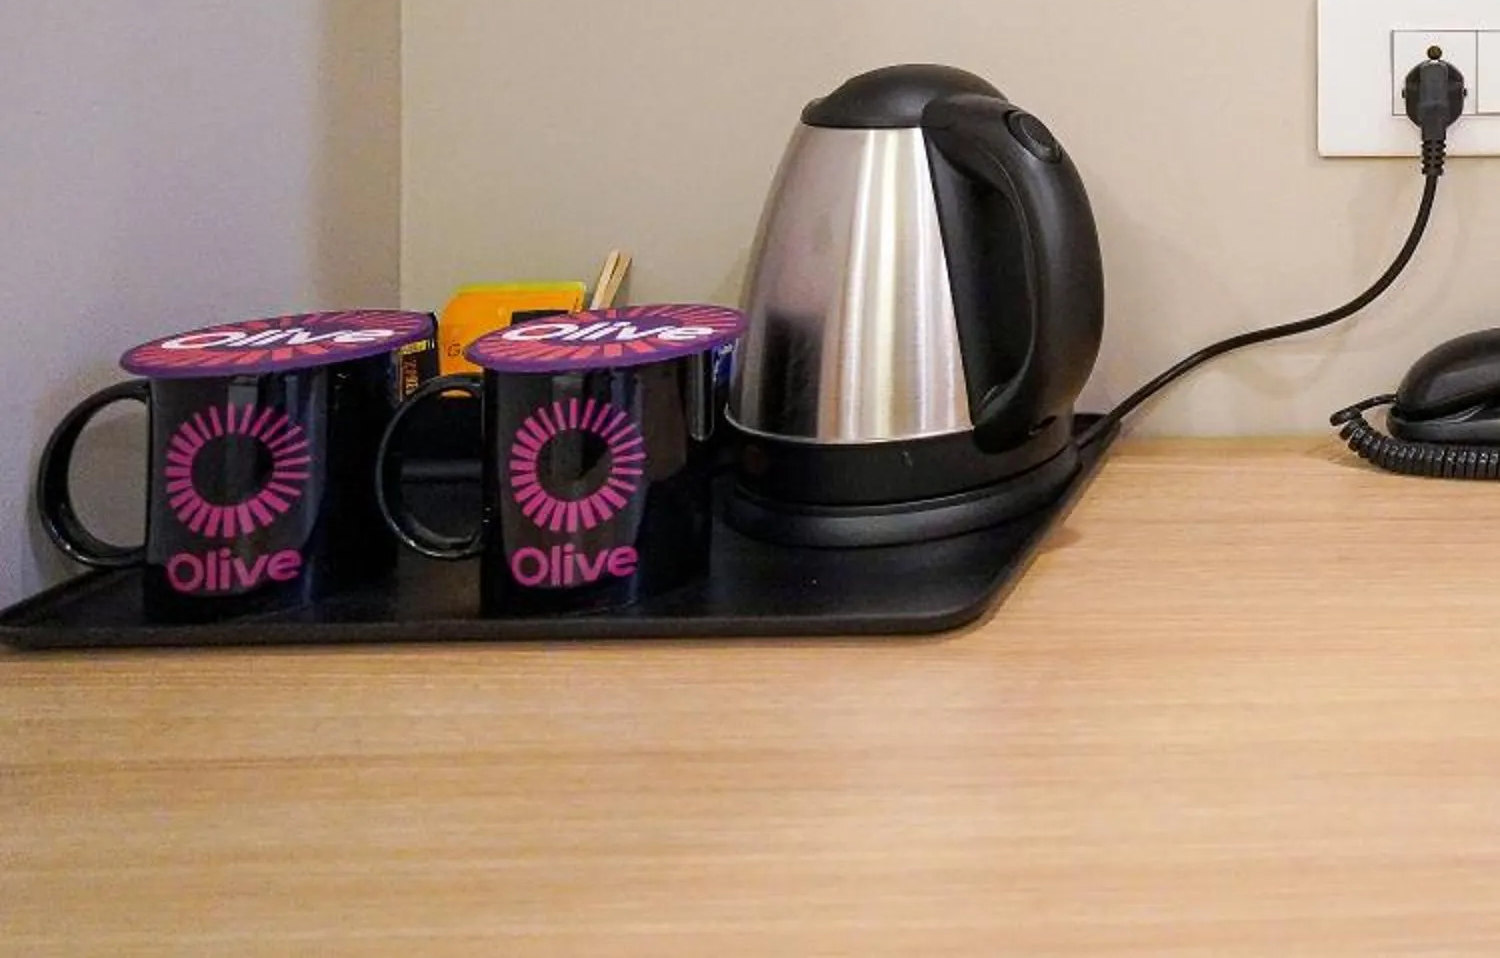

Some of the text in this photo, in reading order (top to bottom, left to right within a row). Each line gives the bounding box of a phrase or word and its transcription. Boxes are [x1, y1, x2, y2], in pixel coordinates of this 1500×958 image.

[161, 327, 395, 350] Olive
[500, 321, 715, 342] Olive
[166, 548, 303, 592] Olive
[510, 543, 640, 587] Olive
